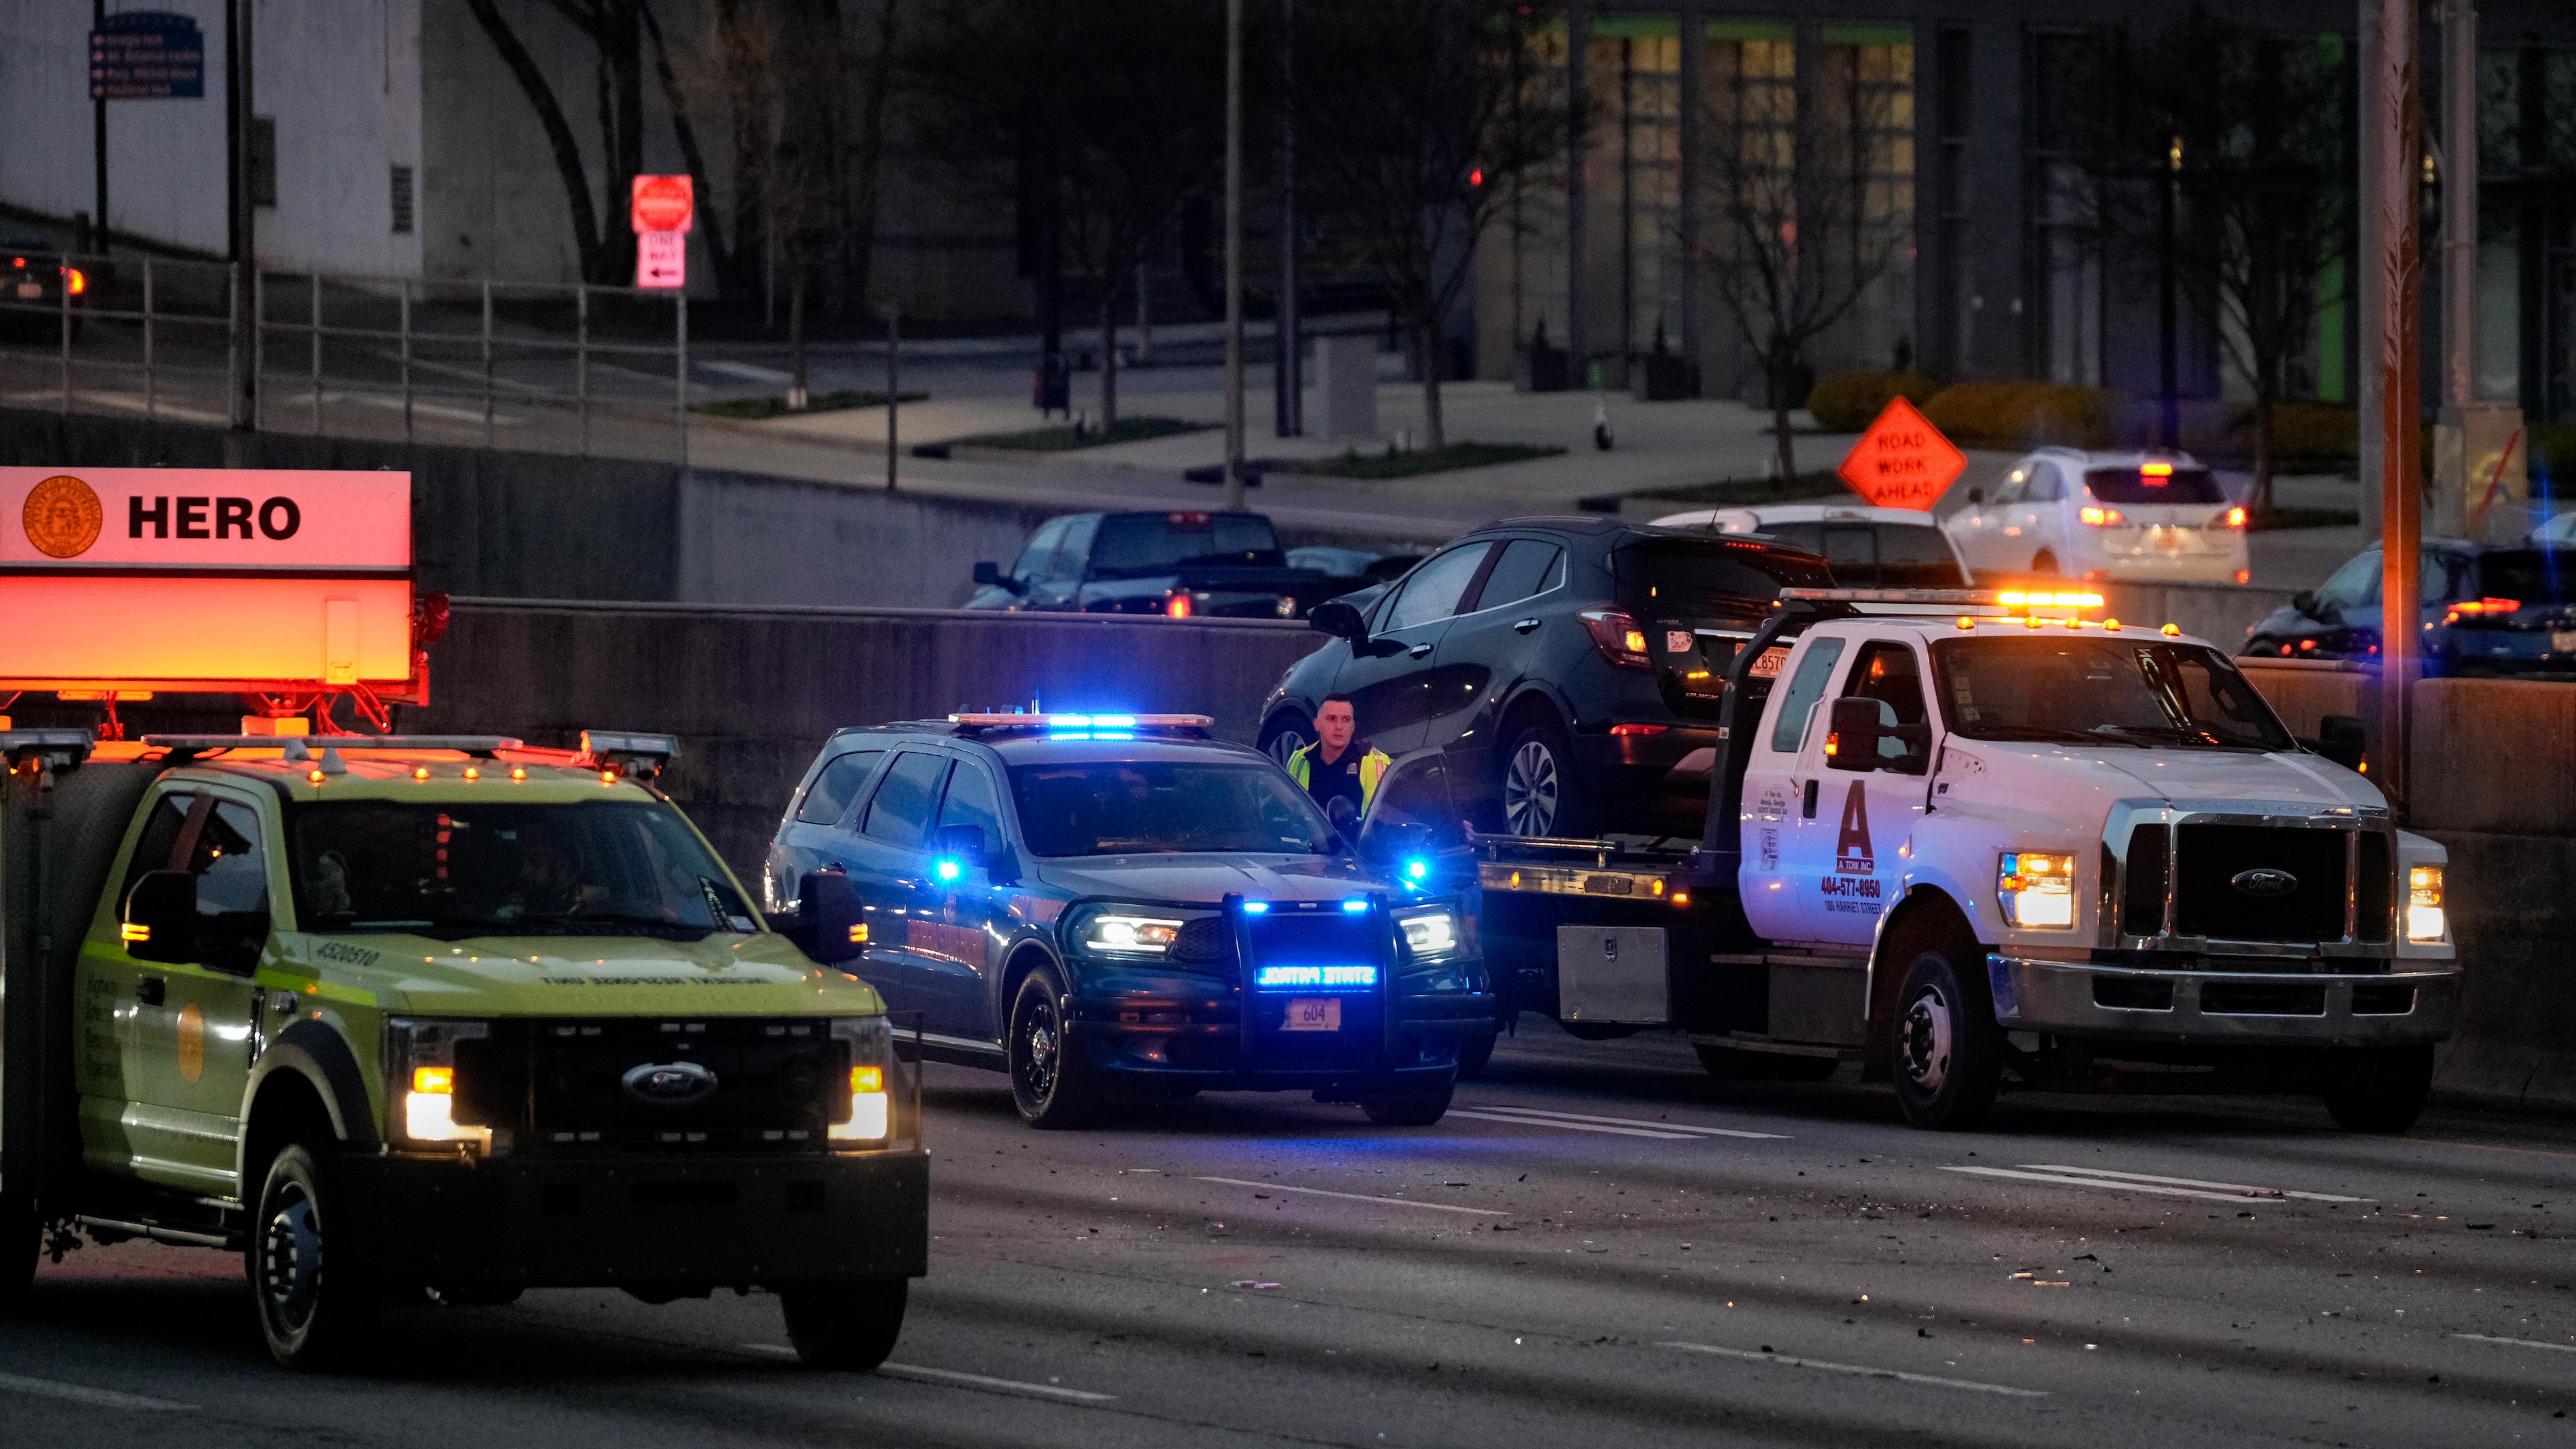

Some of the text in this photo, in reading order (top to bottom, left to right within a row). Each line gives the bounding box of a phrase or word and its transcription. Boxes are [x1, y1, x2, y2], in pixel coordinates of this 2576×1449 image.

[1878, 431, 1926, 449] ROAD
[1878, 459, 1927, 474] WORK
[1875, 482, 1934, 499] AHEAD
[128, 496, 301, 541] HERO
[1836, 779, 1875, 858] A
[1838, 860, 1872, 871] A TOW INC.
[1821, 875, 1880, 898] 404-577-8950
[2249, 872, 2284, 891] Ford
[1825, 900, 1882, 915] 180 HARRIET STREET
[1303, 1004, 1325, 1022] 604
[649, 1072, 694, 1093] Ford
